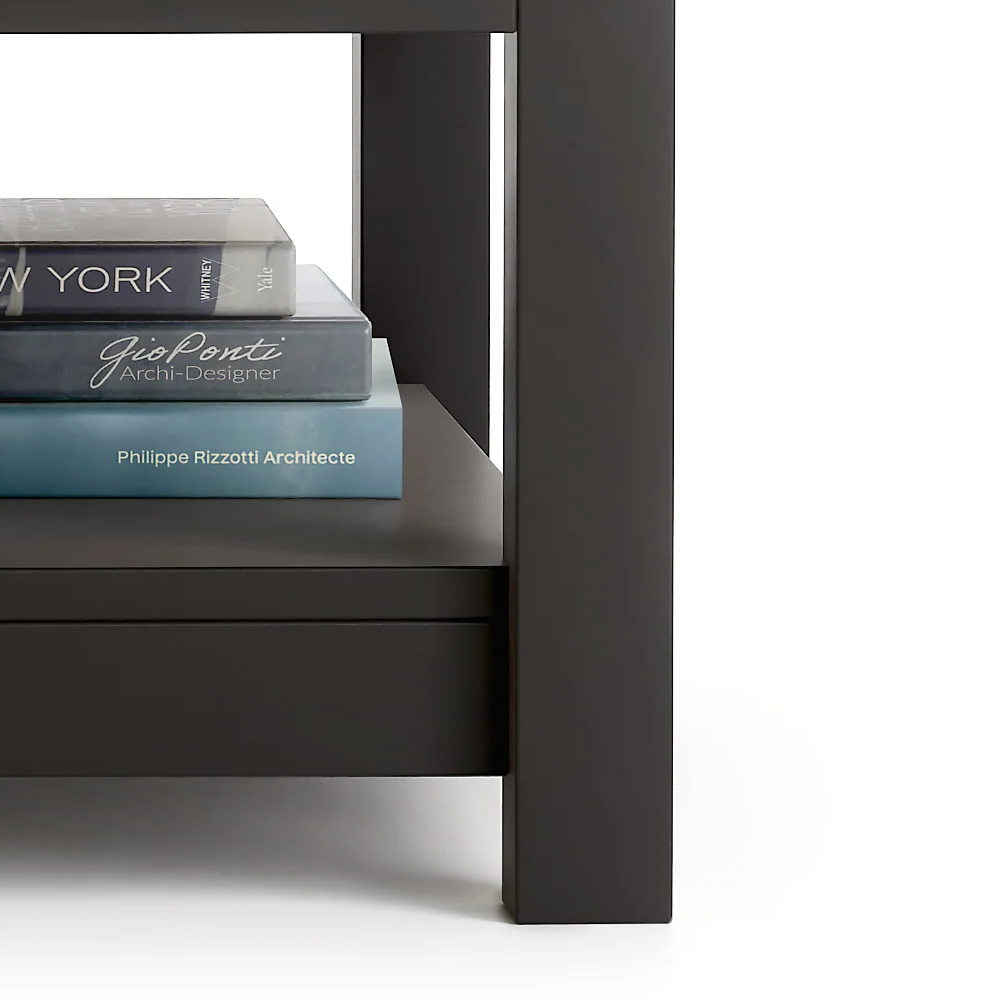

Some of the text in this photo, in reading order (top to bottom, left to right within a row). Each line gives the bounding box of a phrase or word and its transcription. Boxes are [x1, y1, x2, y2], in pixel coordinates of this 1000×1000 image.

[46, 265, 173, 294] YORK
[199, 258, 212, 302] WHITNEY
[257, 267, 273, 293] Yale
[119, 365, 281, 384] Archi-Designer
[117, 449, 356, 469] Philippe Rizzotti Architecte
